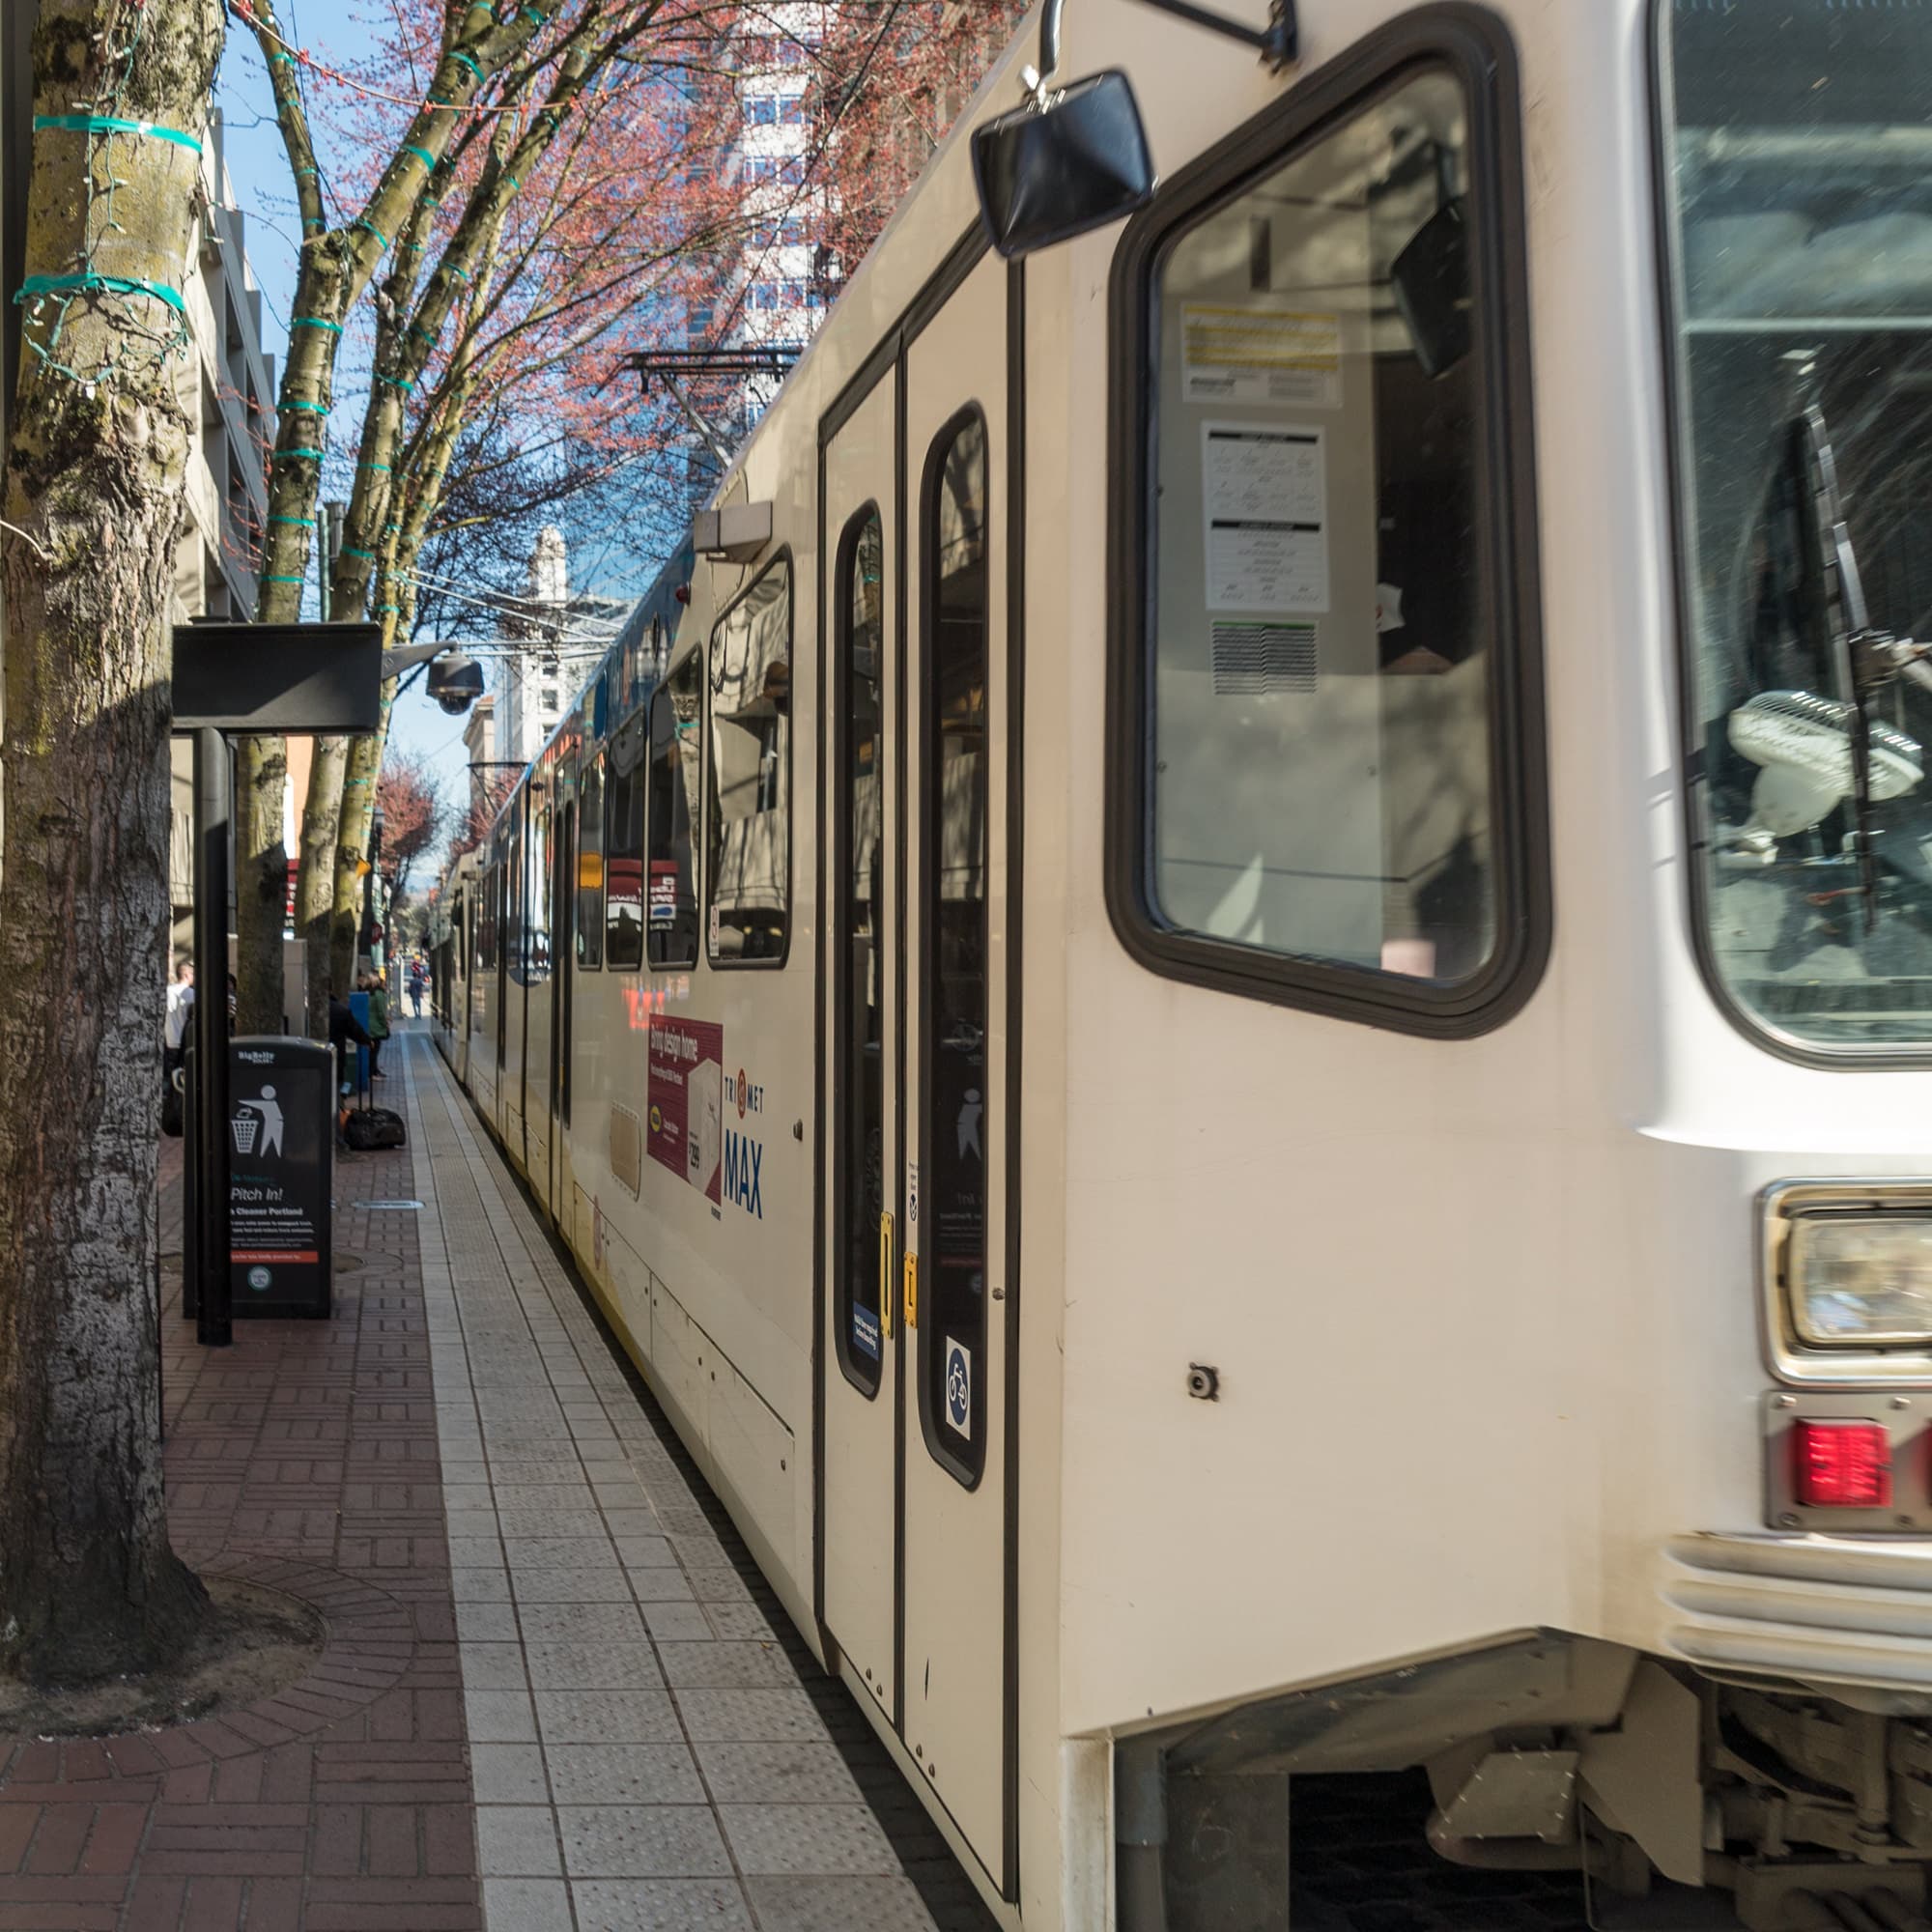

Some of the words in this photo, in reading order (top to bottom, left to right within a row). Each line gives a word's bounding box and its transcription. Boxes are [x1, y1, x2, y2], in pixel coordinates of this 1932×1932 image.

[665, 1025, 680, 1064] design
[681, 1028, 698, 1063] home
[724, 1127, 763, 1220] MAX
[230, 1187, 263, 1202] Pitch
[266, 1187, 284, 1202] In!
[269, 1207, 303, 1216] Portland
